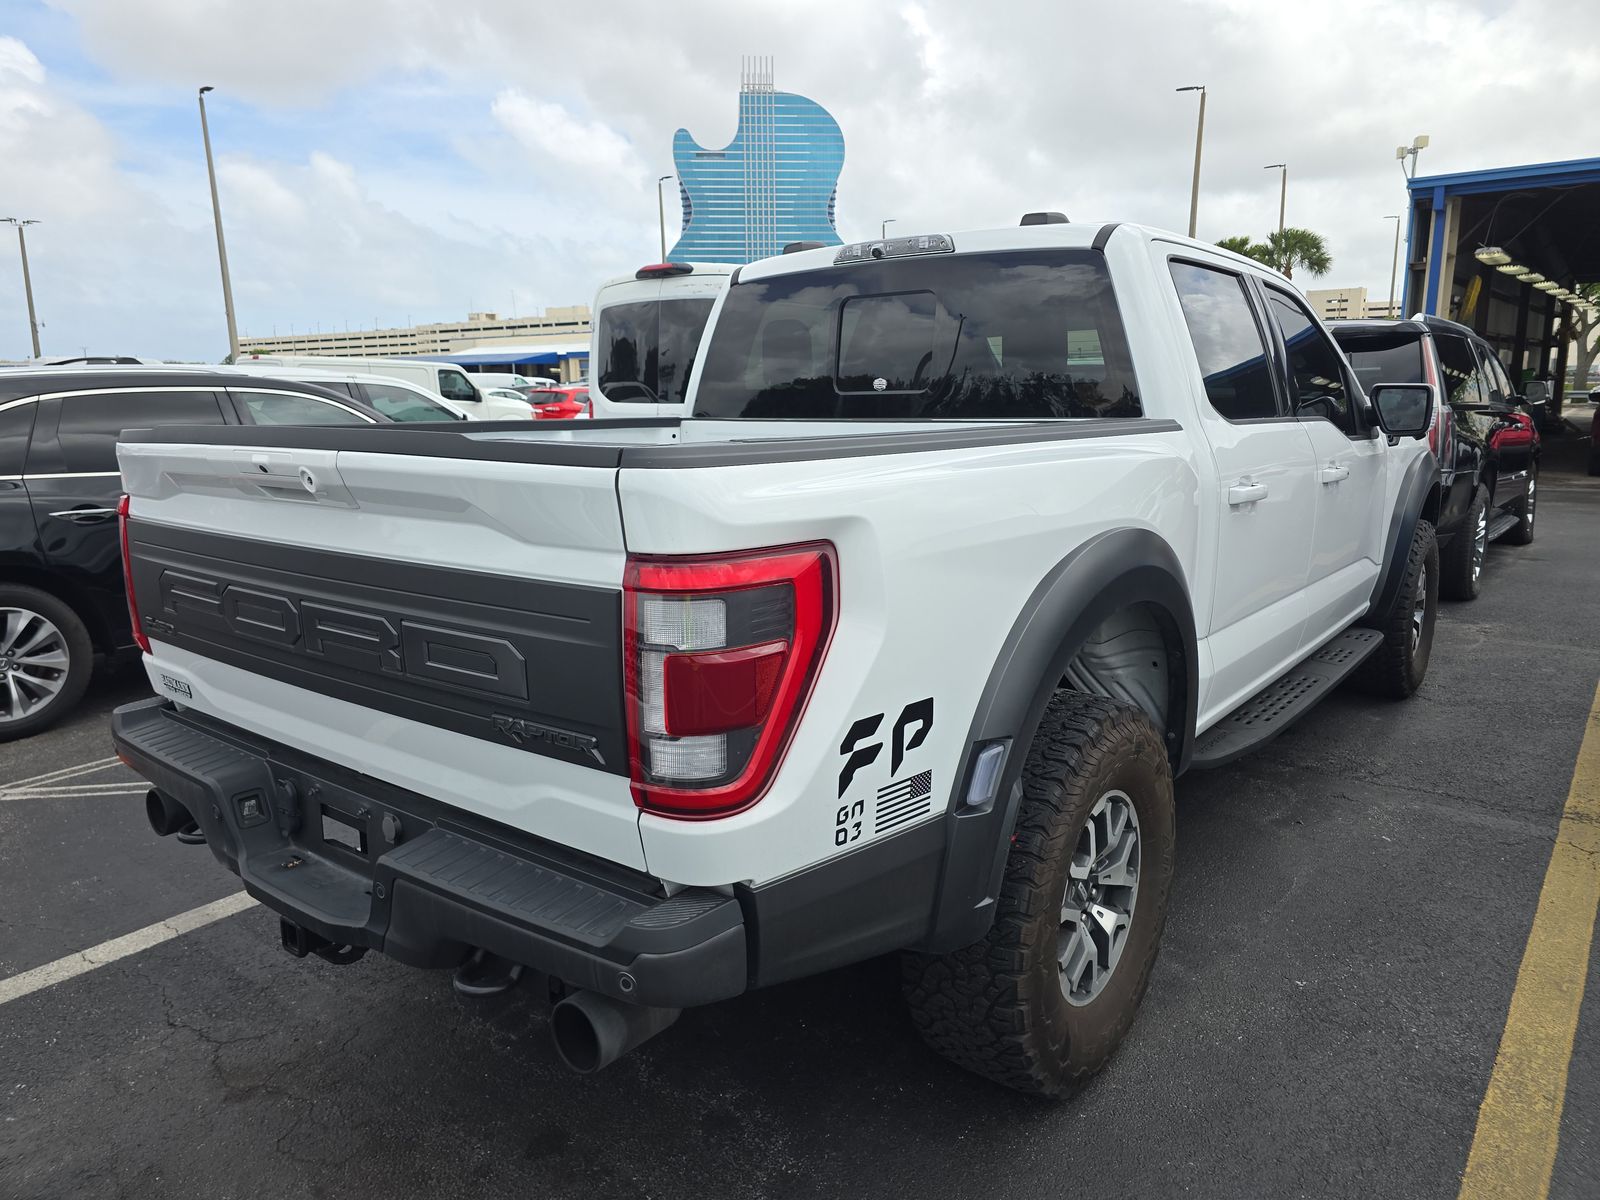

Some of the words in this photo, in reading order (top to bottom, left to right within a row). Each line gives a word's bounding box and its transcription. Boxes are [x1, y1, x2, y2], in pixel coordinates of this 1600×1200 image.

[160, 568, 528, 702] FORD
[492, 713, 605, 765] RAPTOR
[838, 697, 933, 799] FP
